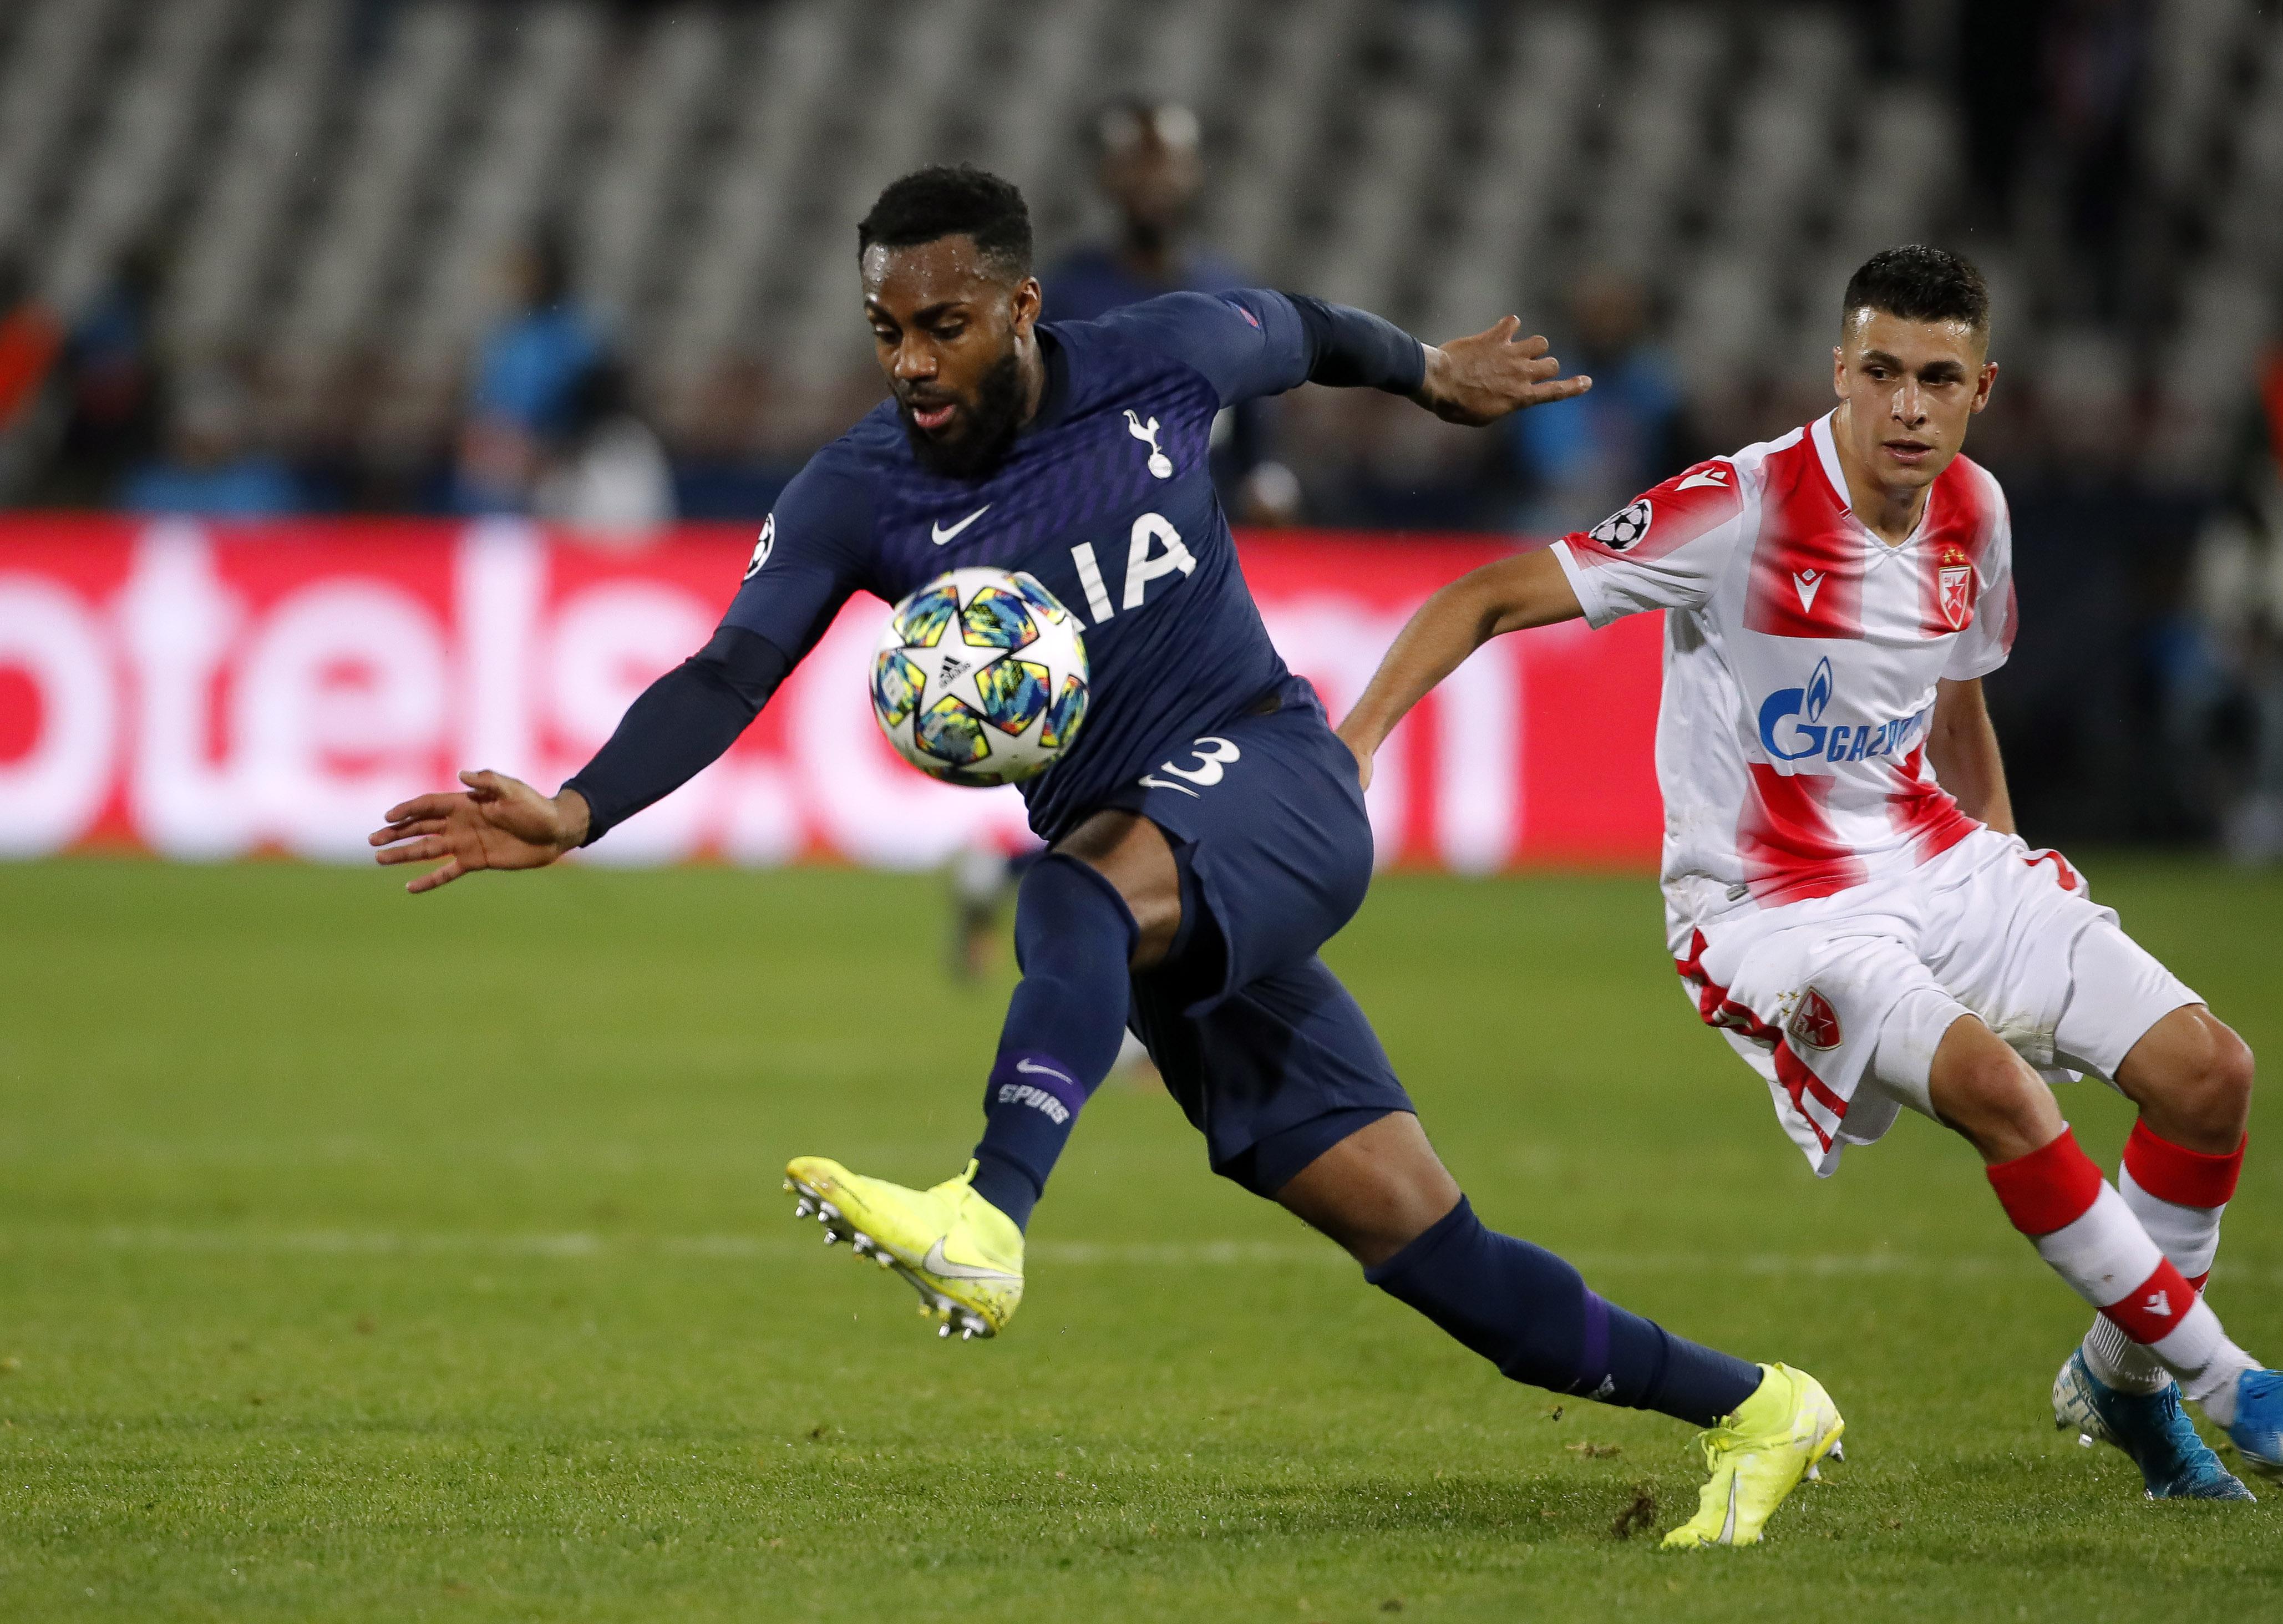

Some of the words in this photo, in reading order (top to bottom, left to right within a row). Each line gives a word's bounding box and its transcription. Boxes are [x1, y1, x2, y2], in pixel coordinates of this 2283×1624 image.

[1014, 512, 1198, 632] IA
[1161, 737, 1241, 786] 3
[998, 1083, 1070, 1125] SPURS
